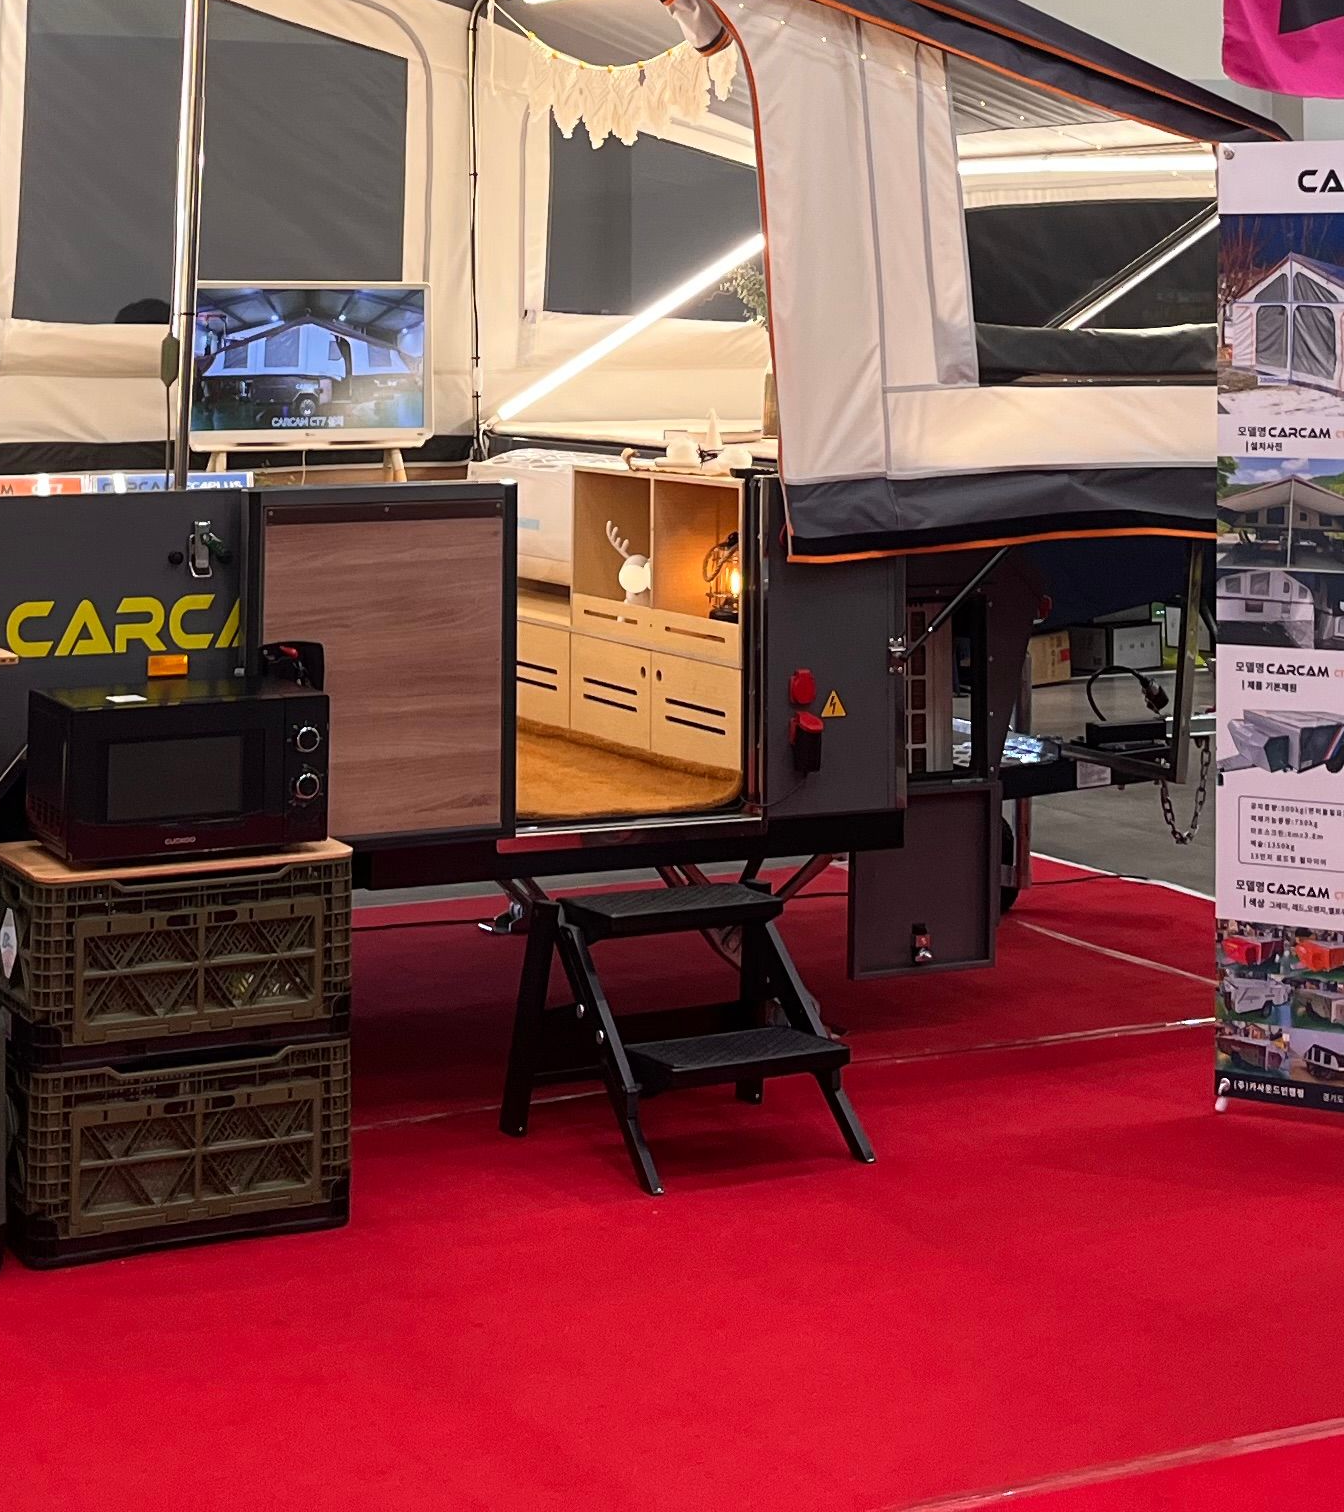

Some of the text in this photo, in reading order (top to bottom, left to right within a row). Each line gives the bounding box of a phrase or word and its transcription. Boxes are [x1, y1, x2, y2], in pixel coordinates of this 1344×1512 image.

[1237, 426, 1266, 437] 모델명
[1268, 427, 1331, 439] CARCAM
[1236, 661, 1264, 673] 모델명
[1266, 663, 1329, 678] CARCAM
[1236, 880, 1264, 892] 모델명
[1267, 882, 1330, 899] CARCAM
[1249, 897, 1265, 908] 색상
